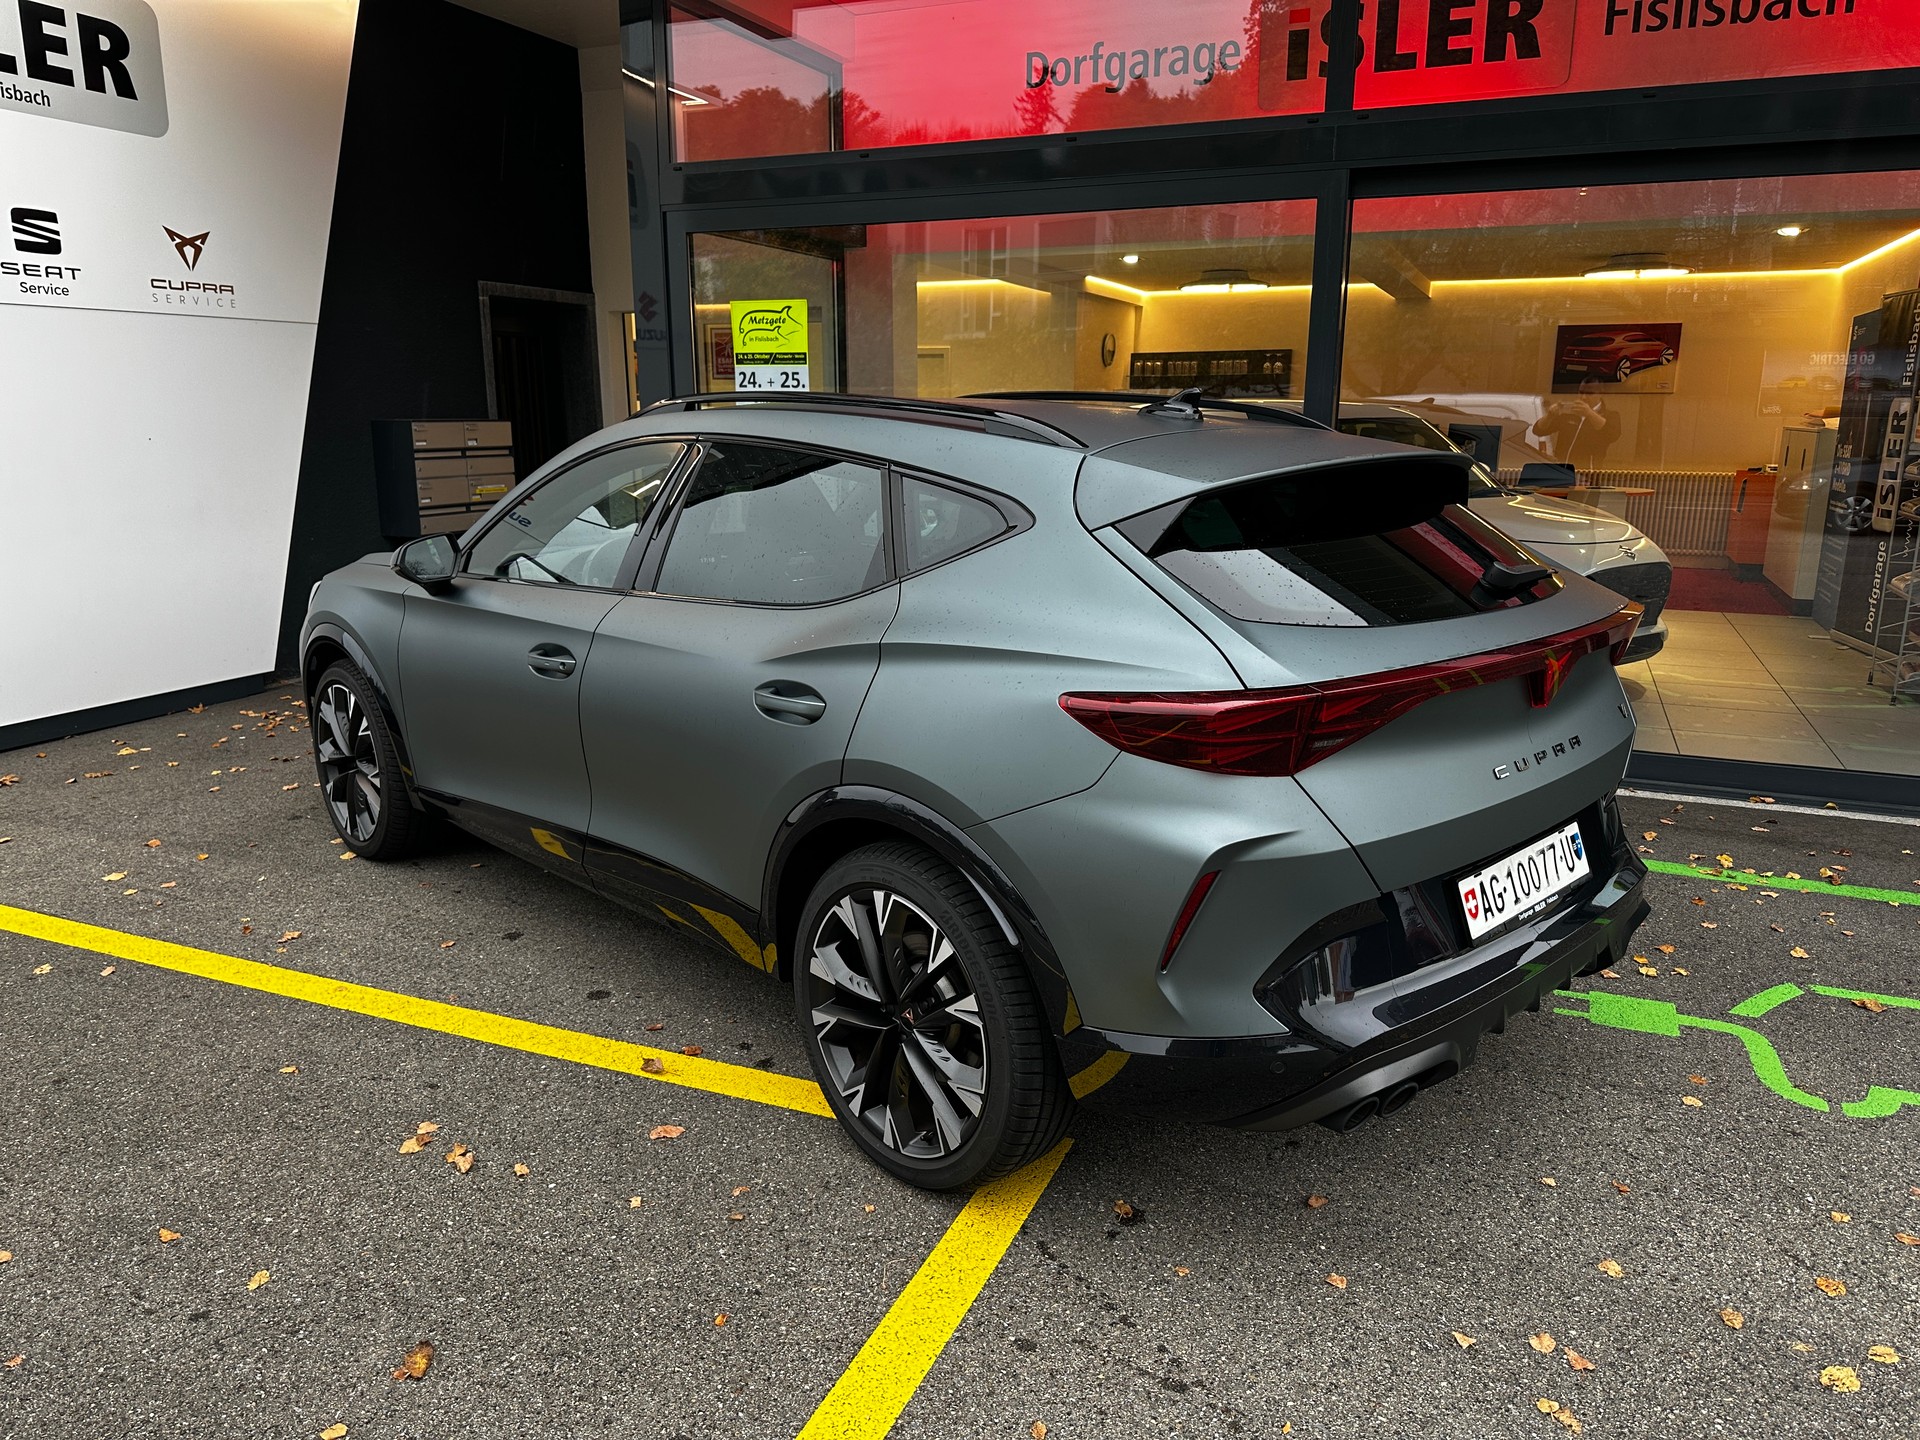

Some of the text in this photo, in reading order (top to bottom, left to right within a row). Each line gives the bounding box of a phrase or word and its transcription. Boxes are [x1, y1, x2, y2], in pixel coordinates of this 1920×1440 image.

[0, 0, 138, 101] ER
[1026, 39, 1241, 94] Dorfgarage
[0, 261, 81, 280] SEAT
[19, 281, 70, 296] Service
[150, 278, 235, 295] CUPRA
[152, 293, 237, 308] SERVICE
[748, 316, 786, 326] Metzgete
[739, 371, 806, 388] 24. + 25.
[1864, 541, 1887, 633] Dorfgarage
[1902, 302, 1920, 386] Fislisbach
[1493, 735, 1582, 780] CUPRA
[939, 909, 999, 1026] BRIDGESTONE
